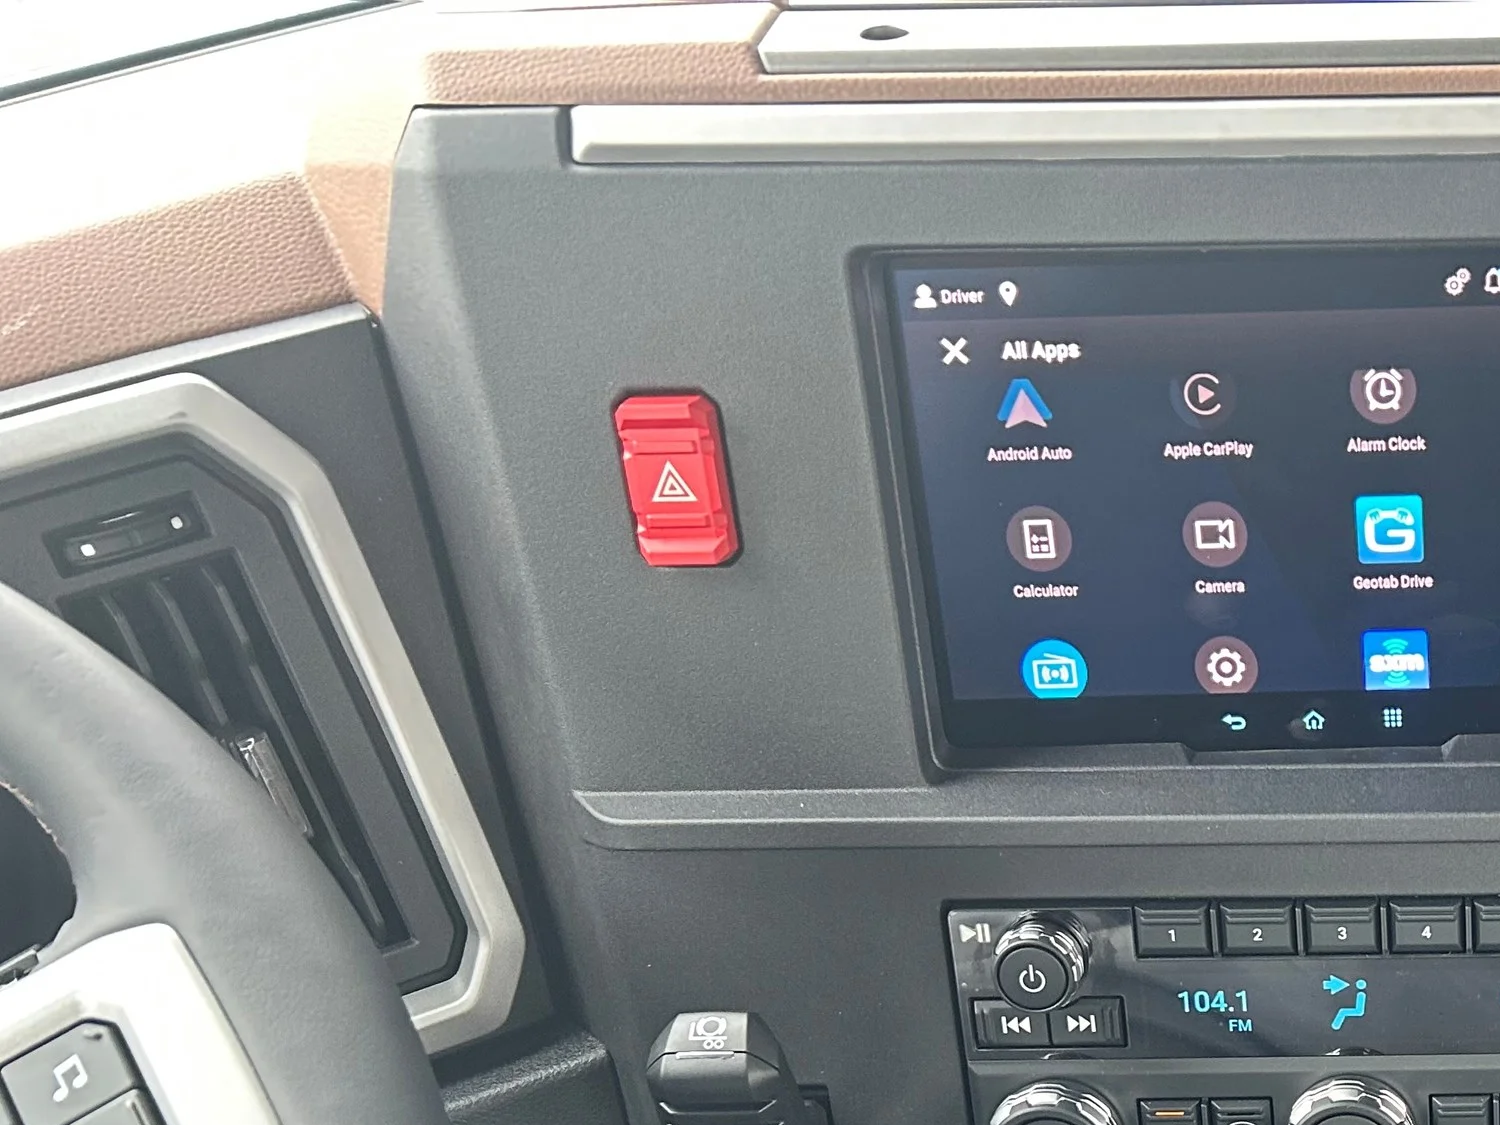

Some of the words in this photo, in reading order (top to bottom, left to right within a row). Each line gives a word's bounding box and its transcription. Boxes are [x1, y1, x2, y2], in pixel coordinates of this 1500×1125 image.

[939, 288, 985, 305] Driver
[1001, 340, 1029, 361] All
[1030, 340, 1082, 364] Apps
[1163, 441, 1202, 459] Apple
[1202, 440, 1254, 459] CarPlay
[1346, 436, 1387, 453] Alarm
[1387, 435, 1427, 452] Clock
[986, 446, 1040, 462] Android
[1041, 446, 1073, 461] Auto
[1194, 579, 1246, 594] Camera
[1352, 574, 1400, 590] Geotab
[1400, 574, 1434, 589] Drive
[1012, 583, 1079, 599] Calculator
[1167, 929, 1176, 942] 1
[1252, 927, 1263, 942] 2
[1337, 926, 1348, 941] 3
[1421, 925, 1432, 939] 4
[1177, 990, 1248, 1013] 104.1
[1228, 1018, 1253, 1032] FM
